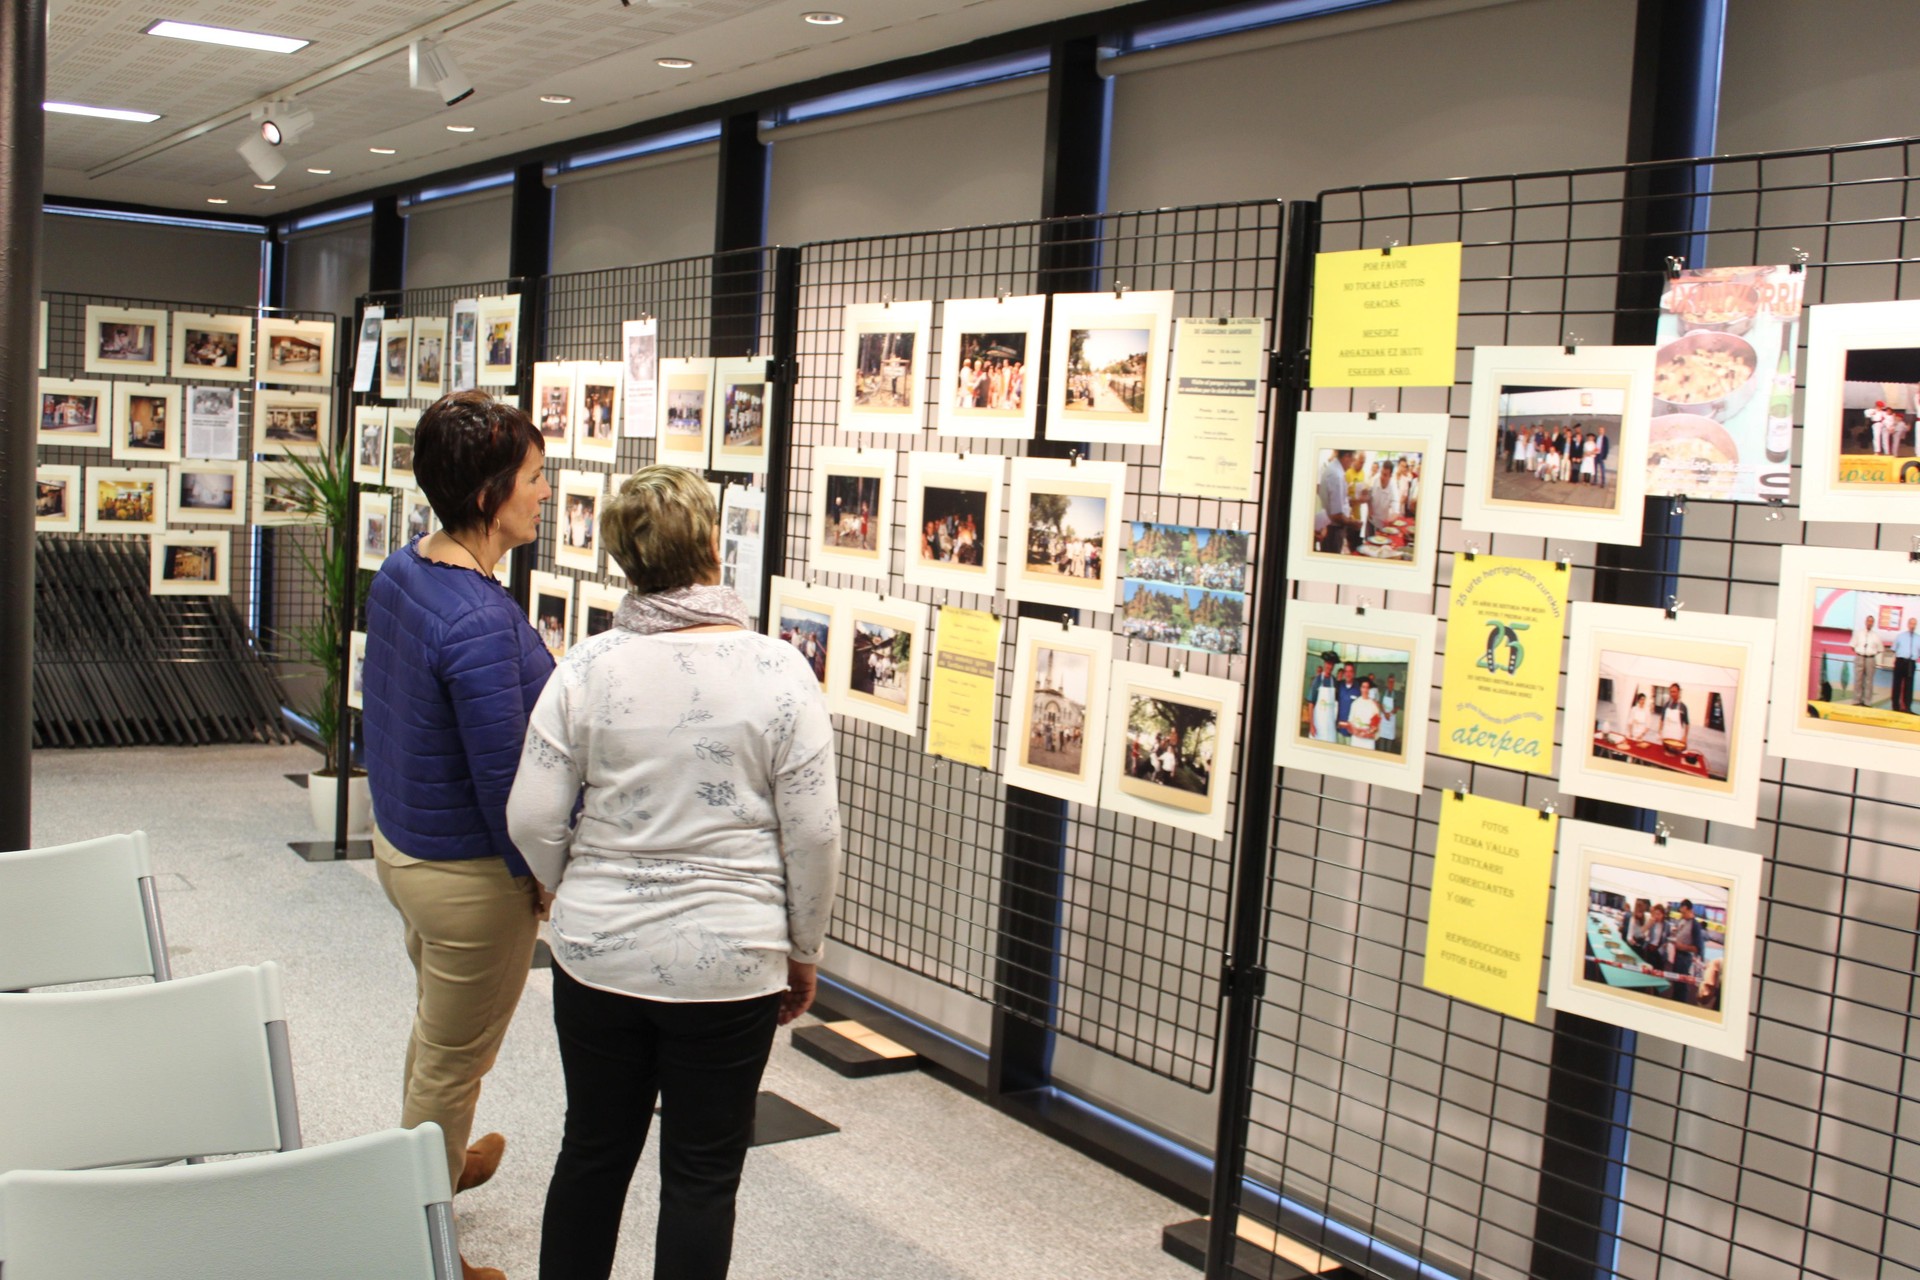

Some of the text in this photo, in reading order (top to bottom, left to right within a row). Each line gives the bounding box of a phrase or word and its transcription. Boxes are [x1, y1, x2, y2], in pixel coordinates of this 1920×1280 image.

[1381, 260, 1407, 270] FAVOR
[1356, 281, 1381, 290] TOCAR
[1383, 280, 1399, 289] LAS
[1400, 278, 1425, 287] FOTOS
[1456, 593, 1468, 607] 25
[1465, 575, 1483, 594] urte
[1535, 582, 1560, 619] zurekin
[1451, 724, 1541, 757] aterpea
[1482, 820, 1510, 835] FOTOS
[1453, 833, 1520, 858] TXEMA VALLES
[1448, 872, 1515, 898] COMERCIANTES
[1440, 950, 1467, 965] FOTOS
[1445, 931, 1521, 962] REPRODUCCIONES
